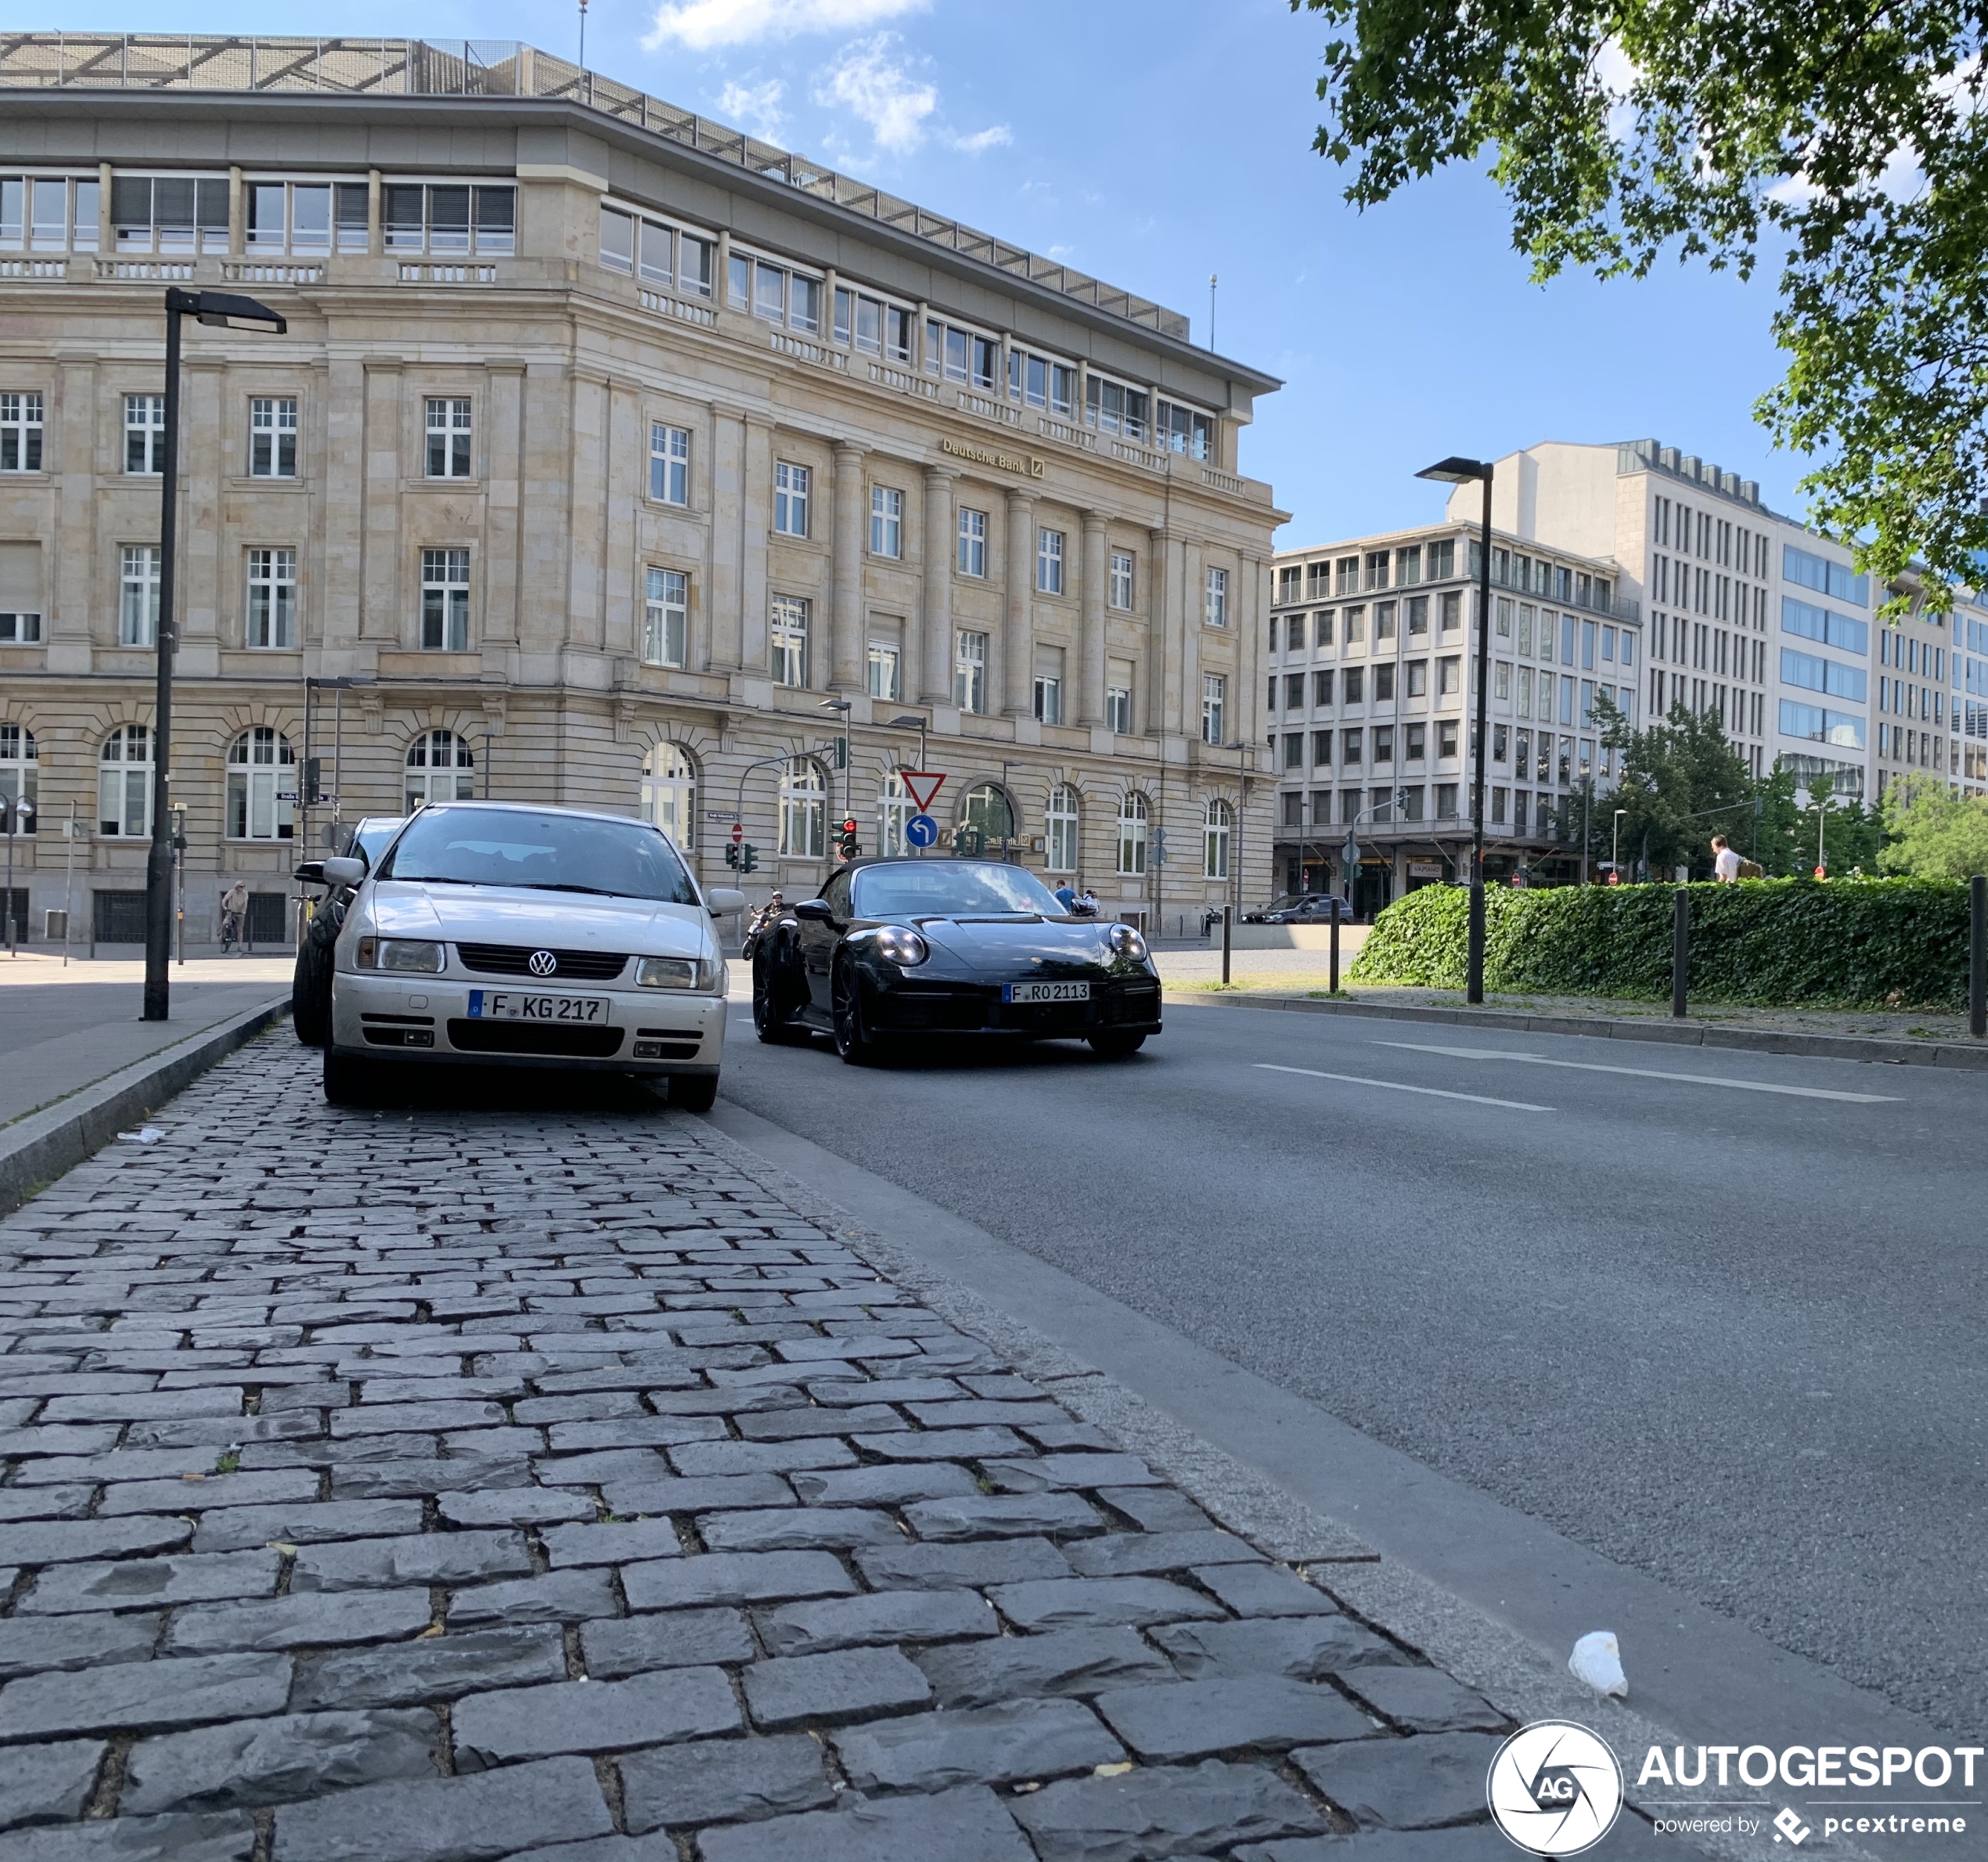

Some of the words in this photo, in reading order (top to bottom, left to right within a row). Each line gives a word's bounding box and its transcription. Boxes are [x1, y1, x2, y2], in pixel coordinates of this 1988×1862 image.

[943, 438, 996, 465] Deutsche
[999, 455, 1025, 474] Bank
[1012, 986, 1021, 1000] F
[1032, 985, 1050, 999] RO
[1053, 984, 1088, 999] 2113
[492, 995, 508, 1015] F
[523, 997, 552, 1018] KG
[557, 999, 600, 1021] 217
